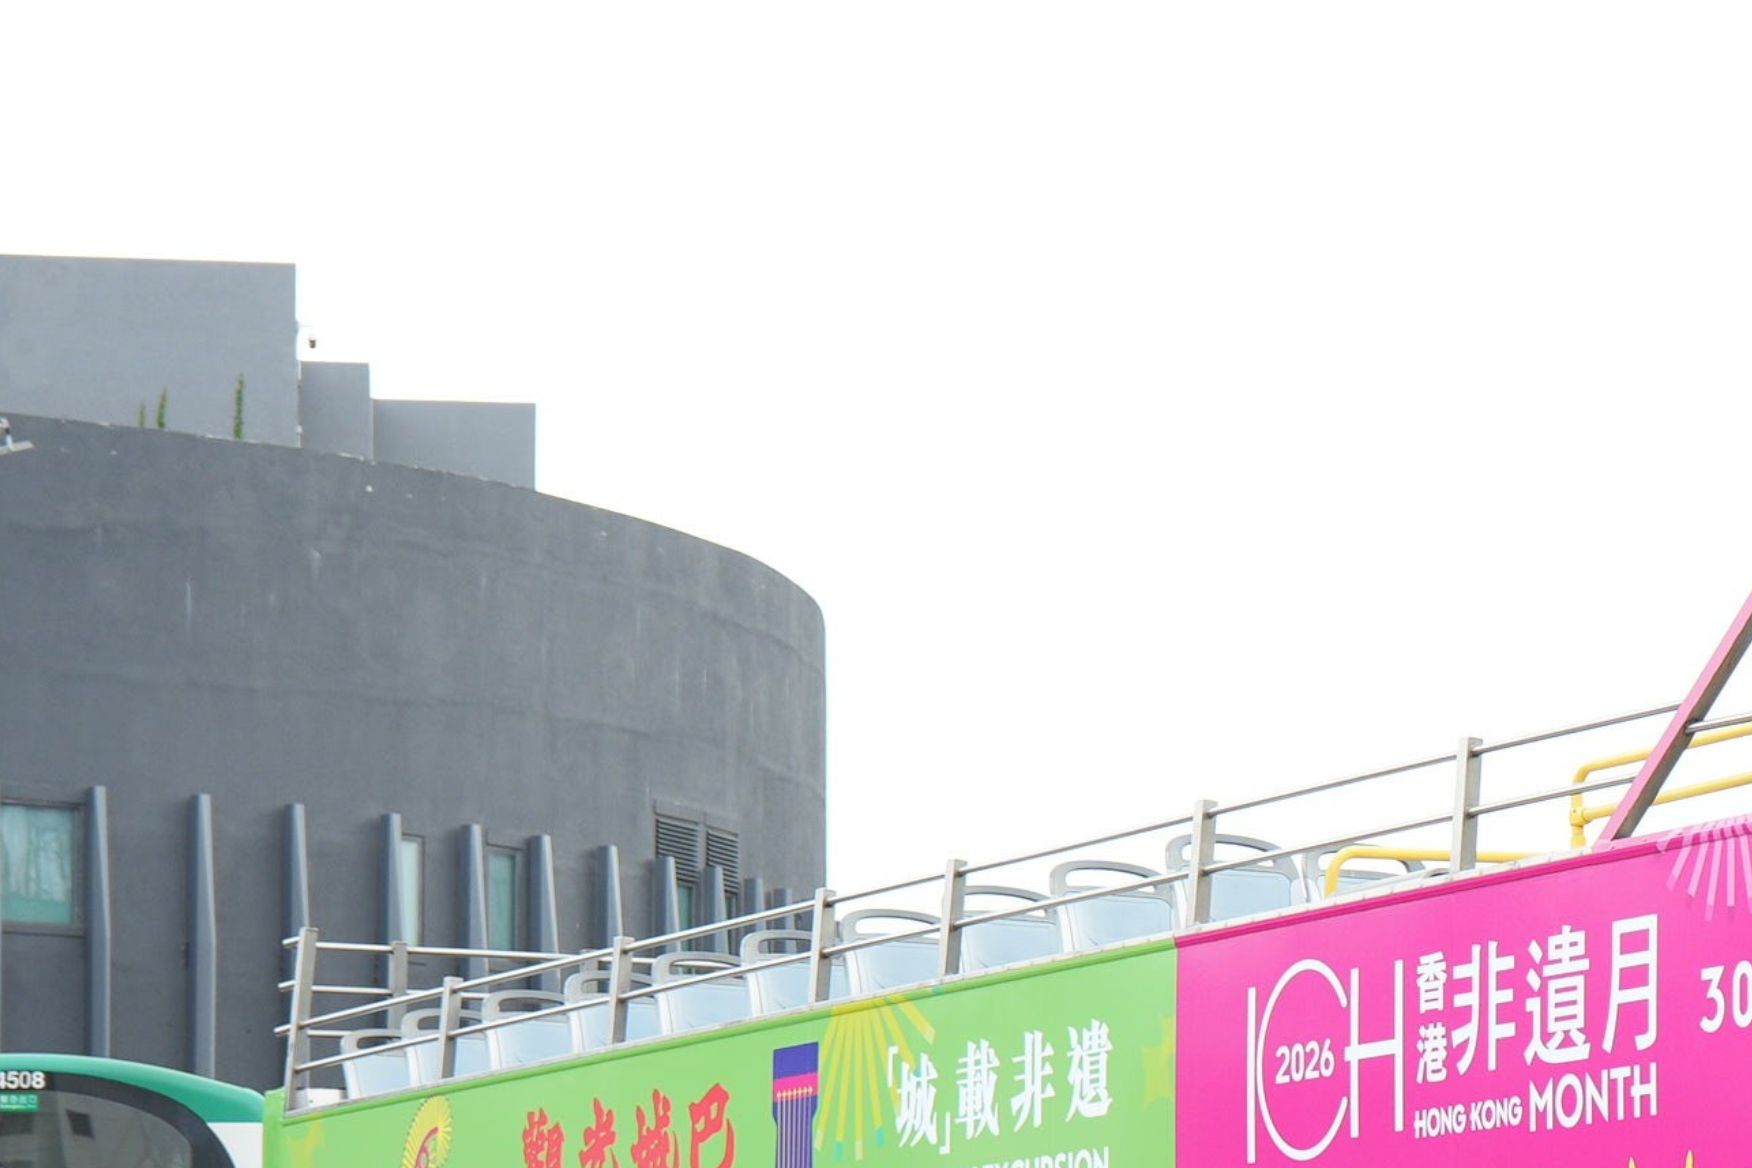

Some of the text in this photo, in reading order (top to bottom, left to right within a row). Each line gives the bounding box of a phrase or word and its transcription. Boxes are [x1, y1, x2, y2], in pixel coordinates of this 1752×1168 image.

[1451, 914, 1658, 1077] 非遺月
[1246, 958, 1404, 1165] ICH
[1274, 1038, 1336, 1085] 2026
[1413, 1062, 1658, 1139] HONG KONG MONTH
